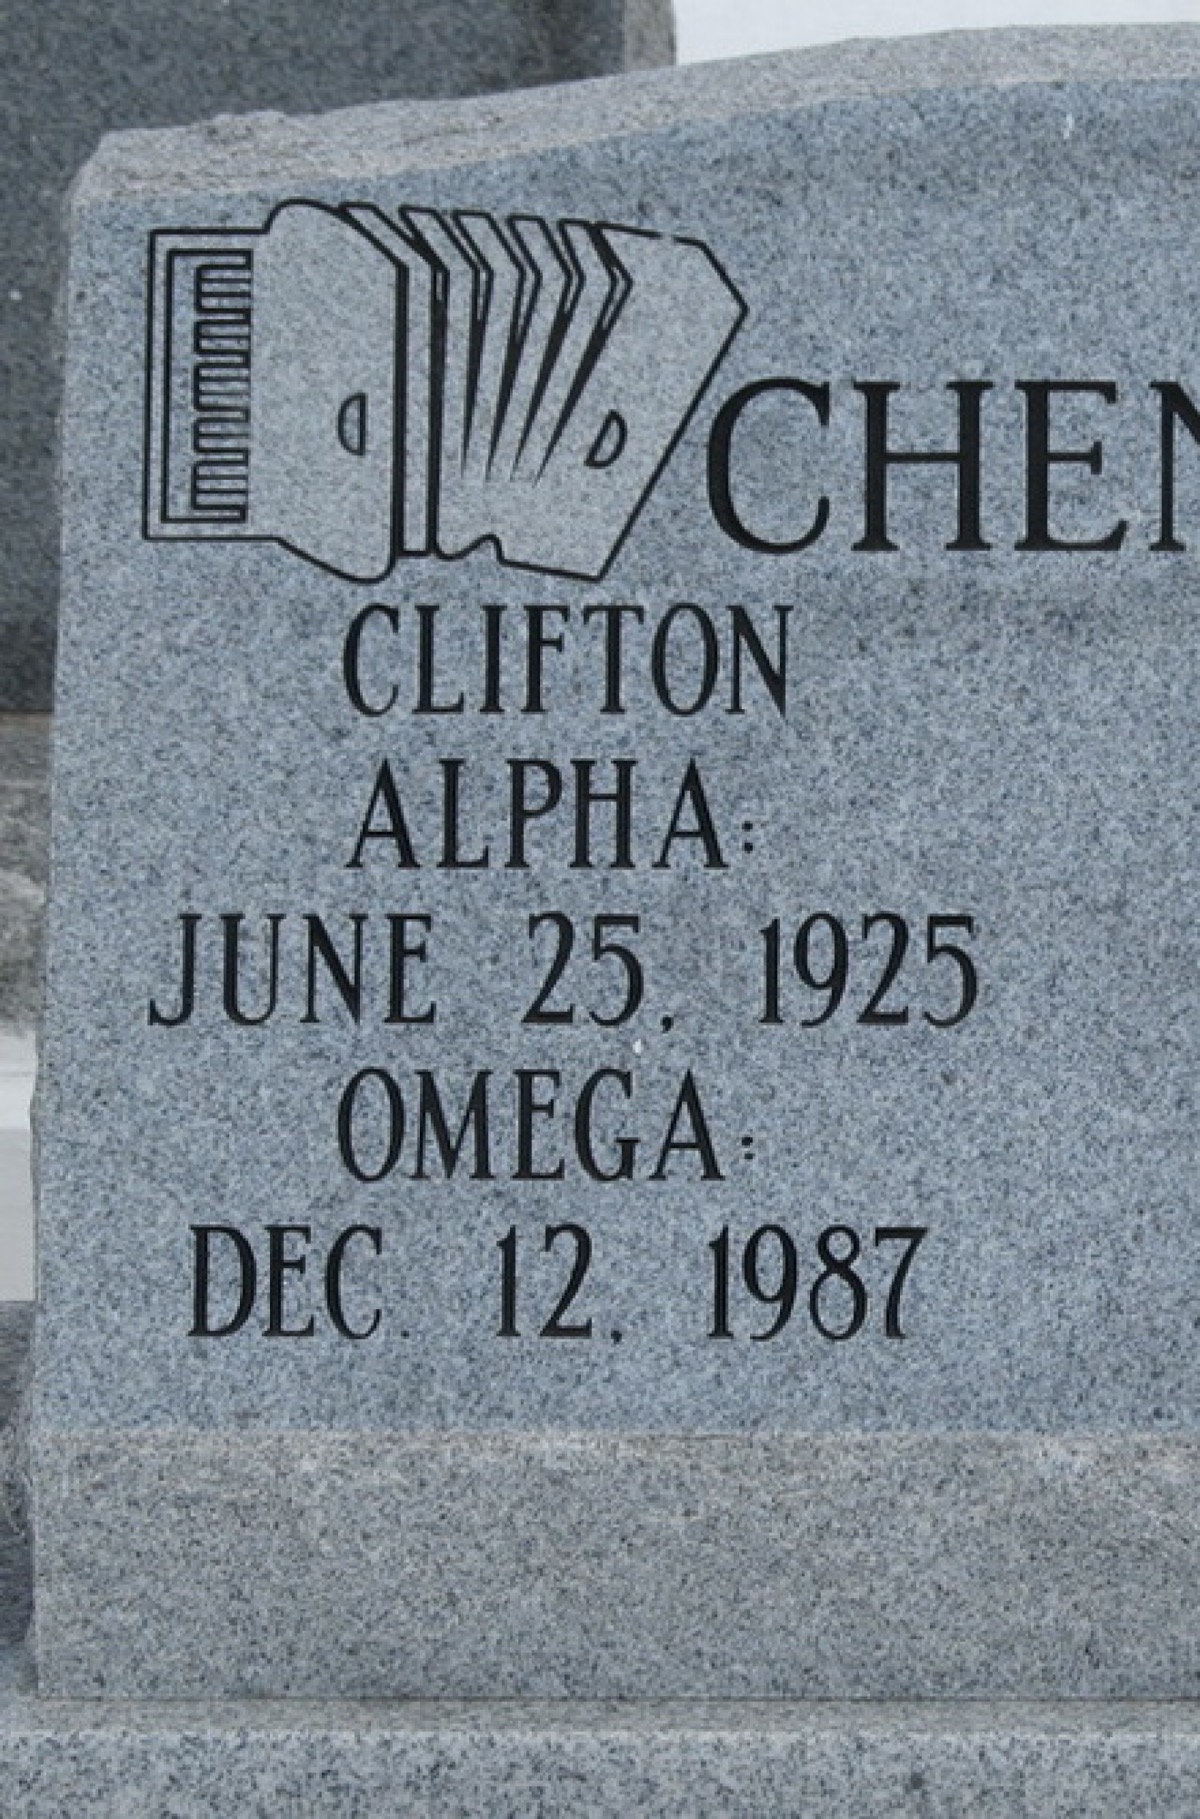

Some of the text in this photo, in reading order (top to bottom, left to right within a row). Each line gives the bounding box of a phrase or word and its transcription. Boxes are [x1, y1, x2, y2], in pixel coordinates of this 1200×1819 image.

[342, 602, 794, 718] CLIFTON
[345, 757, 756, 870] ALPHA:
[148, 910, 979, 1033] JUNE 25, 1925
[336, 1066, 756, 1184] OMEGA:
[187, 1222, 929, 1345] DEC. 12, 1987
